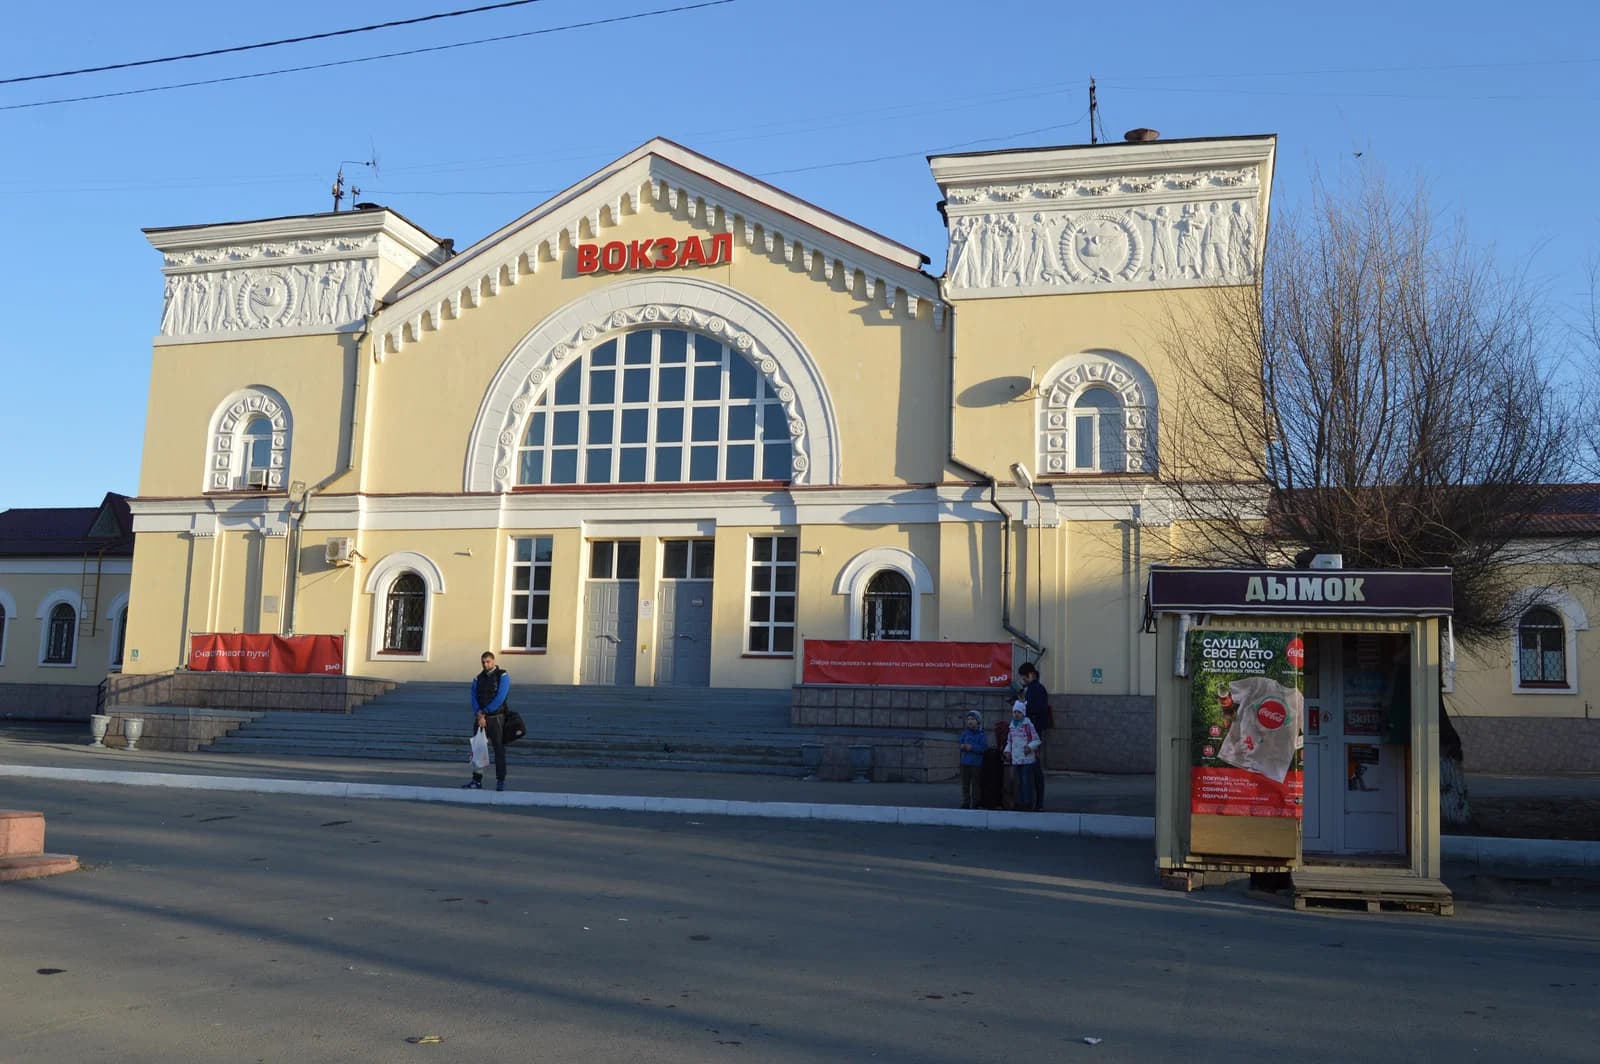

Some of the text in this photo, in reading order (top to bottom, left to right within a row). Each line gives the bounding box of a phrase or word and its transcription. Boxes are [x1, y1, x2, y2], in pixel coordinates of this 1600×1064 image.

[576, 232, 734, 273] ВОКЗАЛ
[1245, 576, 1366, 602] ДЫМОК
[1203, 637, 1259, 649] СЛУШАЙ
[194, 650, 270, 659] Счастливого пути!
[1203, 649, 1273, 660] СВОЕ ЛЕТО
